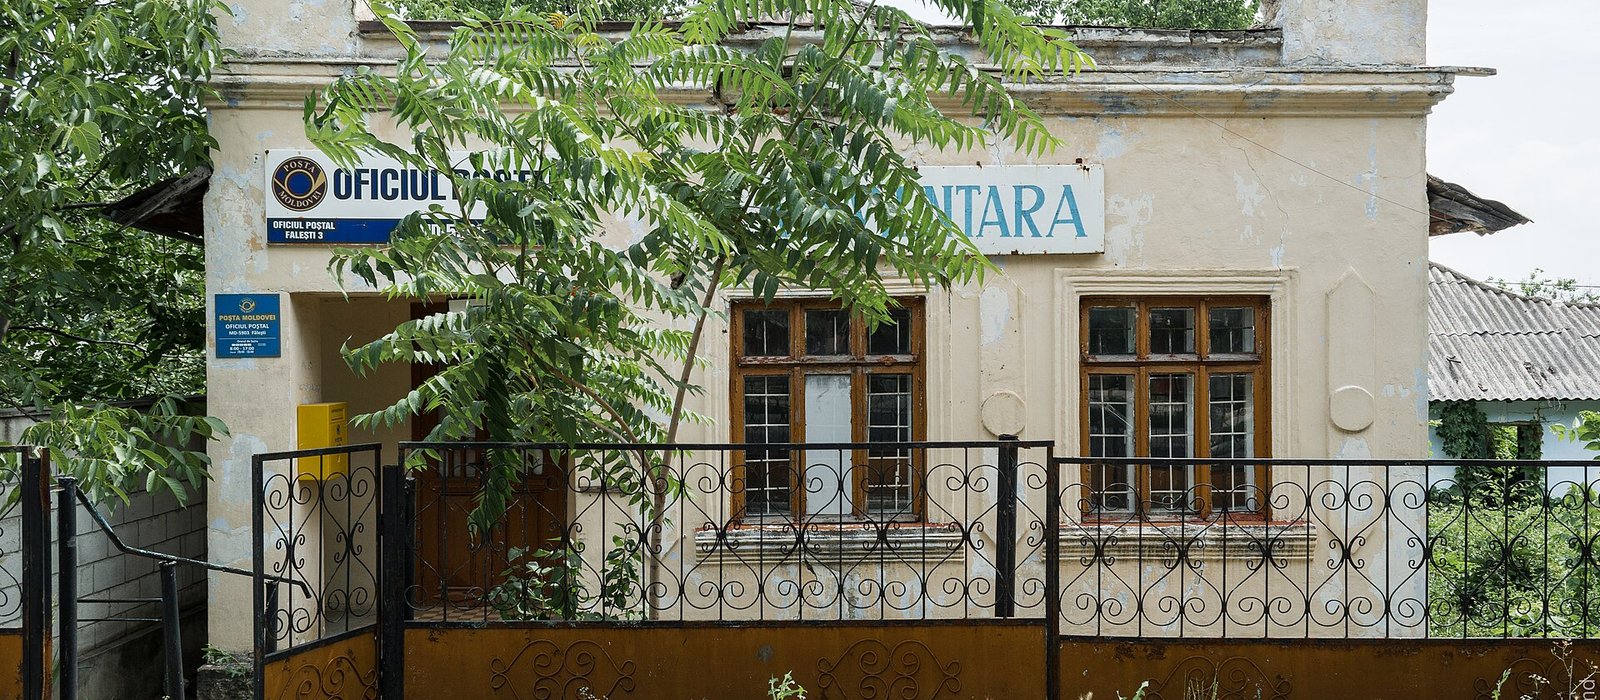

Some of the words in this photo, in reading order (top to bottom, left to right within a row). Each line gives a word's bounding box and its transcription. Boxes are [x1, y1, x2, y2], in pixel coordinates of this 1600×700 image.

[333, 168, 446, 201] OFICIUL
[278, 190, 322, 207] MOLDOVEI
[272, 220, 304, 229] OFICIUL
[317, 231, 324, 240] 3
